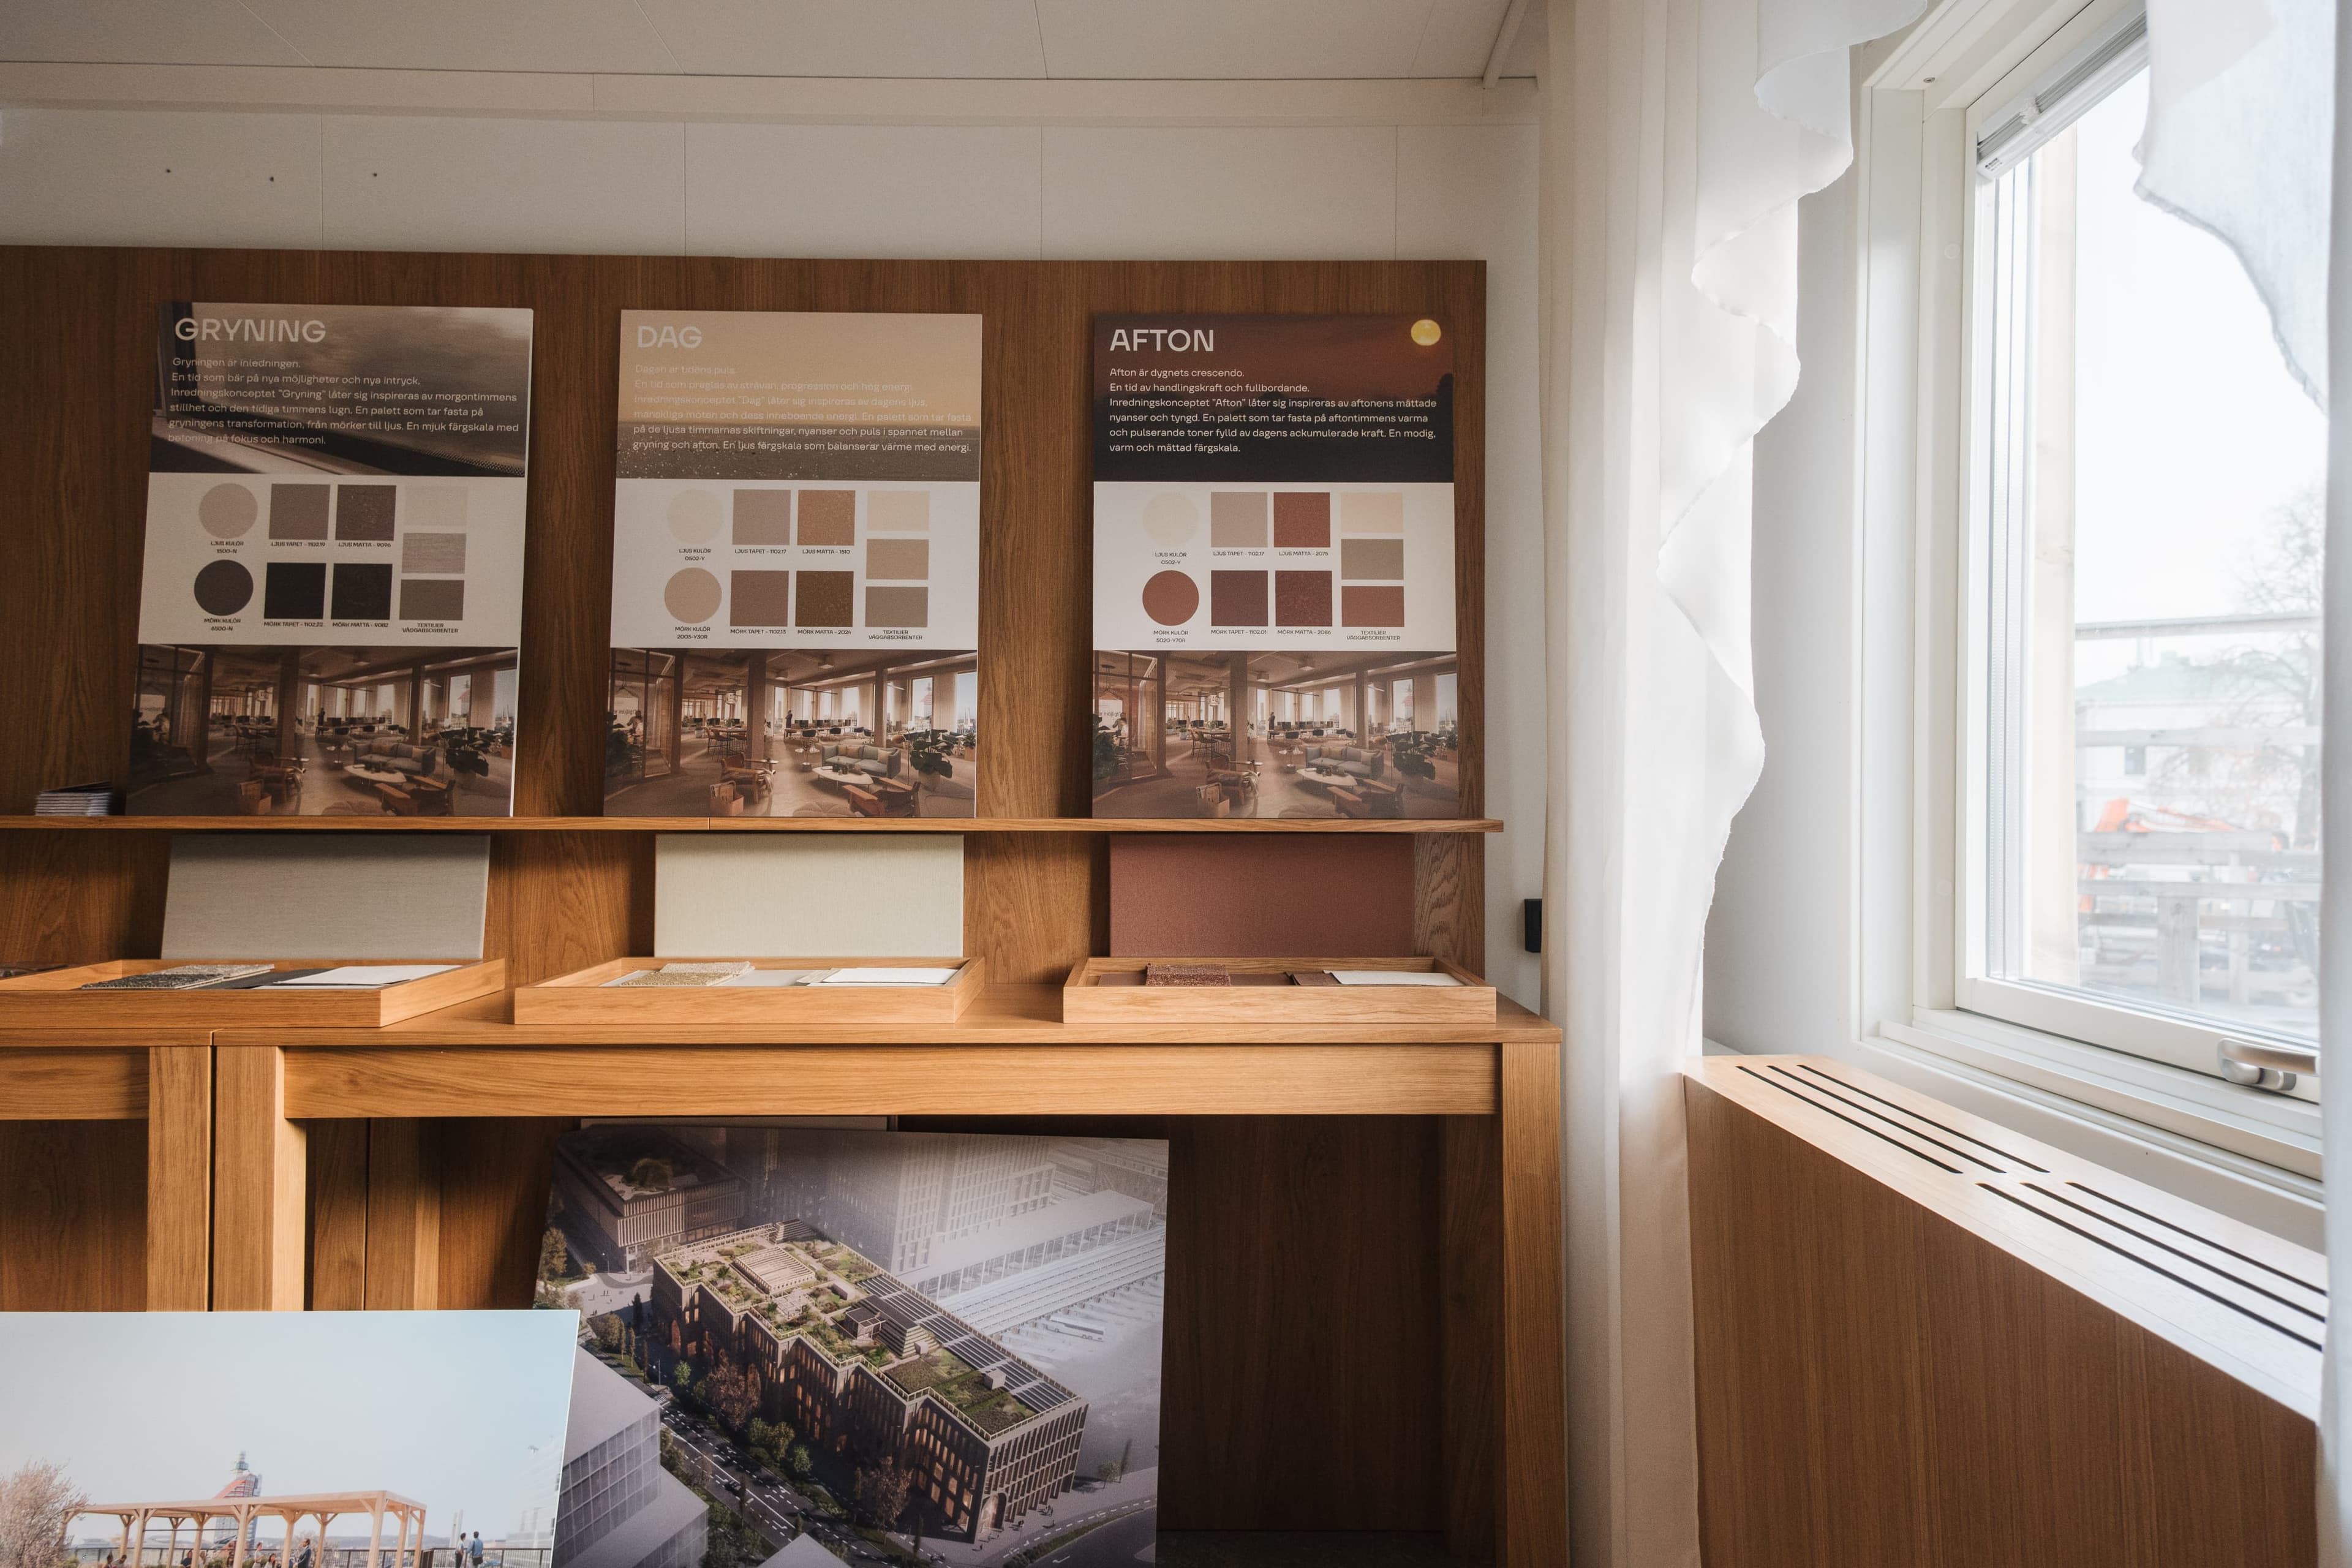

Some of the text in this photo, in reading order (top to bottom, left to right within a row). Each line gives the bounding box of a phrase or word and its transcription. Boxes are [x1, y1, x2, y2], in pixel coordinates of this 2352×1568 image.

[175, 318, 326, 343] GRYNING
[637, 325, 702, 349] DAG
[1110, 328, 1214, 352] AFTON
[172, 373, 185, 382] En
[187, 374, 201, 382] tid
[227, 374, 244, 382] bär
[246, 374, 259, 385] på
[262, 376, 280, 385] nya
[282, 374, 339, 386] möjligheter
[341, 375, 361, 384] och
[363, 377, 382, 386] nya
[1110, 368, 1245, 379] Afton är dygnets crescendo.
[1124, 383, 1137, 392] tid
[1153, 383, 1223, 394] handlingskraft
[1224, 383, 1243, 392] och
[1245, 383, 1310, 393] fullbordande.
[328, 390, 352, 399] låter
[353, 391, 368, 401] sig
[370, 391, 419, 402] inspireras
[435, 392, 518, 404] morgontimmens
[1110, 398, 1210, 409] Inredningskonceptet
[1272, 399, 1286, 409] sig
[1288, 399, 1335, 409] inspireras
[1351, 399, 1394, 407] aftonens
[1396, 399, 1437, 407] mättade
[169, 403, 205, 412] stillhet
[207, 404, 227, 412] och
[328, 405, 353, 417] lugn.
[355, 406, 369, 415] En
[371, 406, 401, 417] palett
[426, 407, 441, 415] tar
[443, 407, 468, 416] fasta
[470, 407, 484, 418] på
[1110, 415, 1148, 424] nyanser
[1150, 413, 1168, 422] och
[1170, 413, 1200, 424] tyngd.
[1202, 413, 1215, 422] En
[1217, 413, 1246, 424] palett
[1271, 413, 1285, 422] tar
[1287, 413, 1311, 422] fasta
[1313, 413, 1326, 424] på
[1328, 413, 1396, 422] aftontimmens
[168, 418, 224, 430] gryningens
[306, 420, 327, 429] från
[368, 421, 381, 430] till
[383, 421, 404, 432] ljus.
[405, 422, 420, 431] En
[421, 422, 446, 433] mjuk
[448, 423, 494, 434] färgskala
[496, 423, 519, 432] med
[633, 424, 963, 438] på de ljusa timmarnas skiftningar, nyanser och puls i spannet mellan
[231, 434, 258, 443] fokus
[260, 434, 280, 443] och
[1109, 428, 1128, 437] och
[1129, 428, 1185, 439] pulserande
[1186, 428, 1213, 437] toner
[1215, 429, 1237, 439] fylld
[1252, 429, 1287, 439] dagens
[1289, 429, 1359, 437] ackumulerade
[1361, 429, 1386, 437] kraft.
[1388, 429, 1401, 437] En
[1403, 429, 1436, 439] modig,
[632, 440, 669, 451] gryning
[671, 441, 690, 450] och
[692, 441, 720, 450] afton.
[722, 441, 736, 450] En
[738, 441, 755, 452] ljus
[756, 442, 802, 452] färgskala
[827, 442, 879, 451] balanserar
[881, 442, 912, 451] värme
[914, 442, 936, 451] med
[938, 443, 971, 453] energi.
[1136, 443, 1155, 451] och
[1156, 443, 1191, 451] mättad
[1193, 443, 1240, 454] färgskala.
